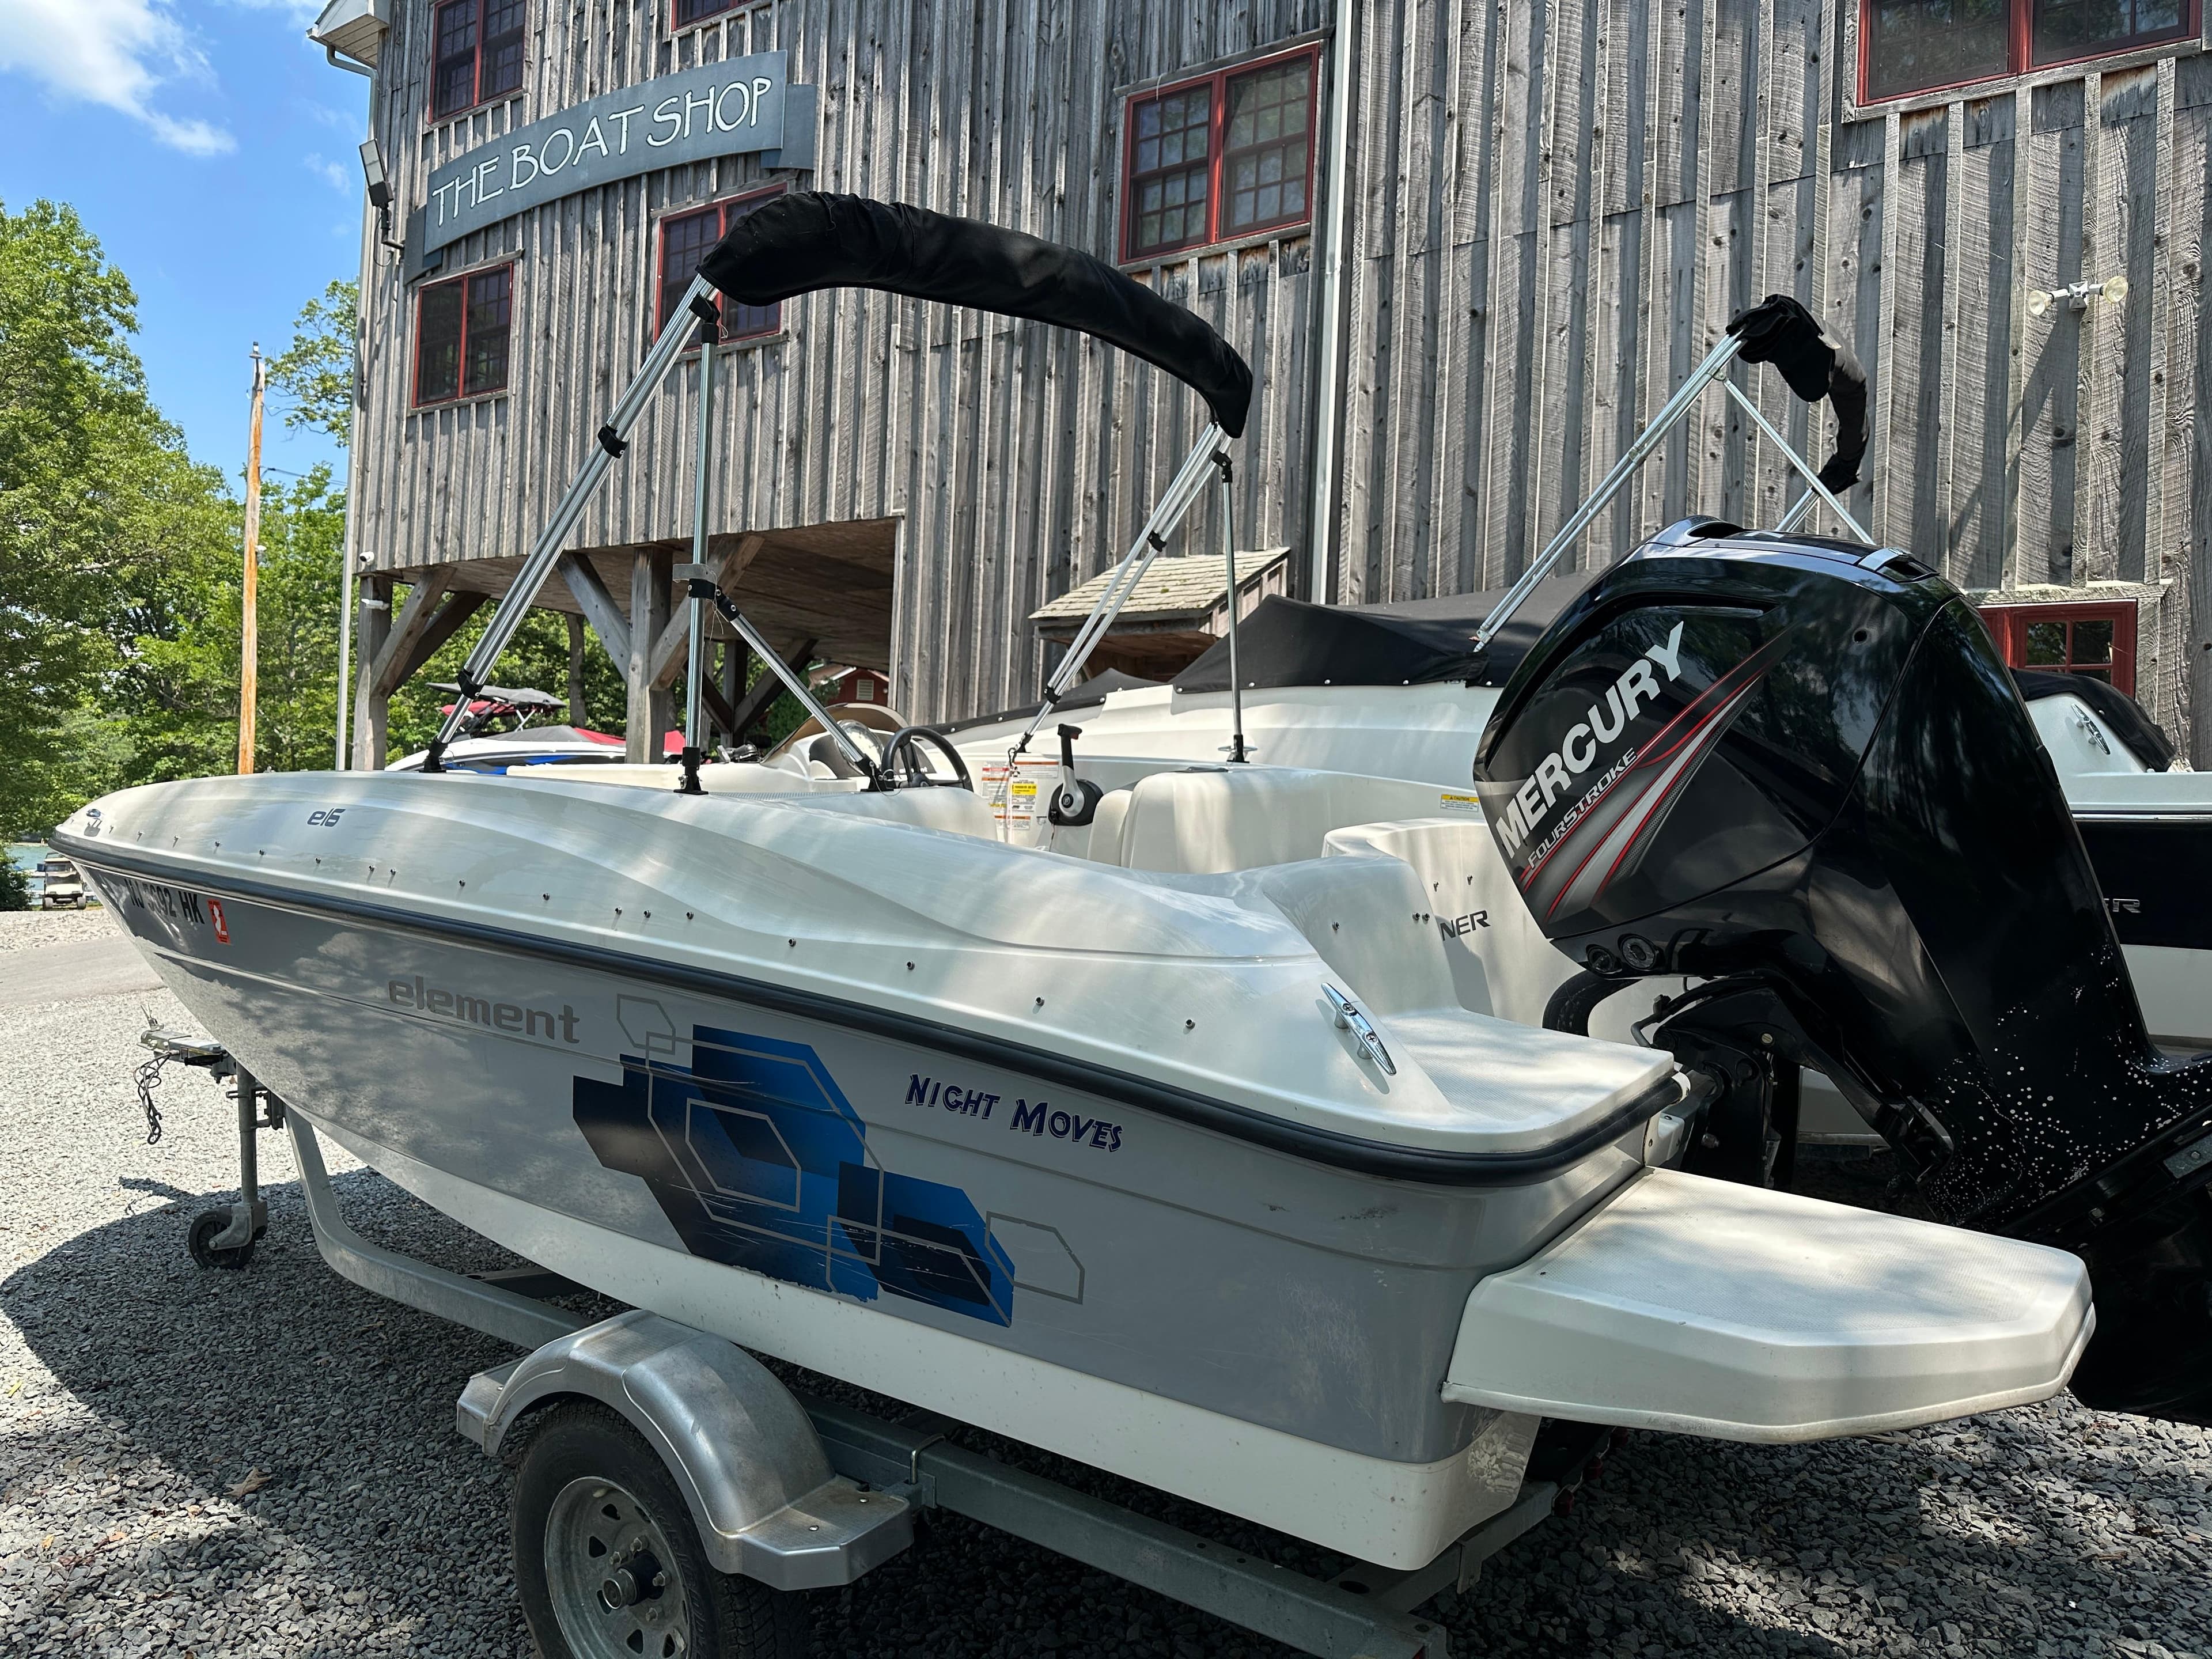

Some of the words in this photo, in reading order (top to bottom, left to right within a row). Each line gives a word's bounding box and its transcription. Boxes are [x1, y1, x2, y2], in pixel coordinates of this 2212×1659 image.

[432, 156, 503, 227] THE
[509, 104, 645, 191] BOAT
[646, 77, 772, 147] SHOP
[1495, 621, 1684, 858] MERCURY
[1528, 747, 1638, 869] FOURSTROKE
[177, 890, 206, 925] HK
[388, 975, 580, 1044] element
[905, 1074, 1001, 1120] NIGHT
[1009, 1098, 1123, 1153] MOVES
